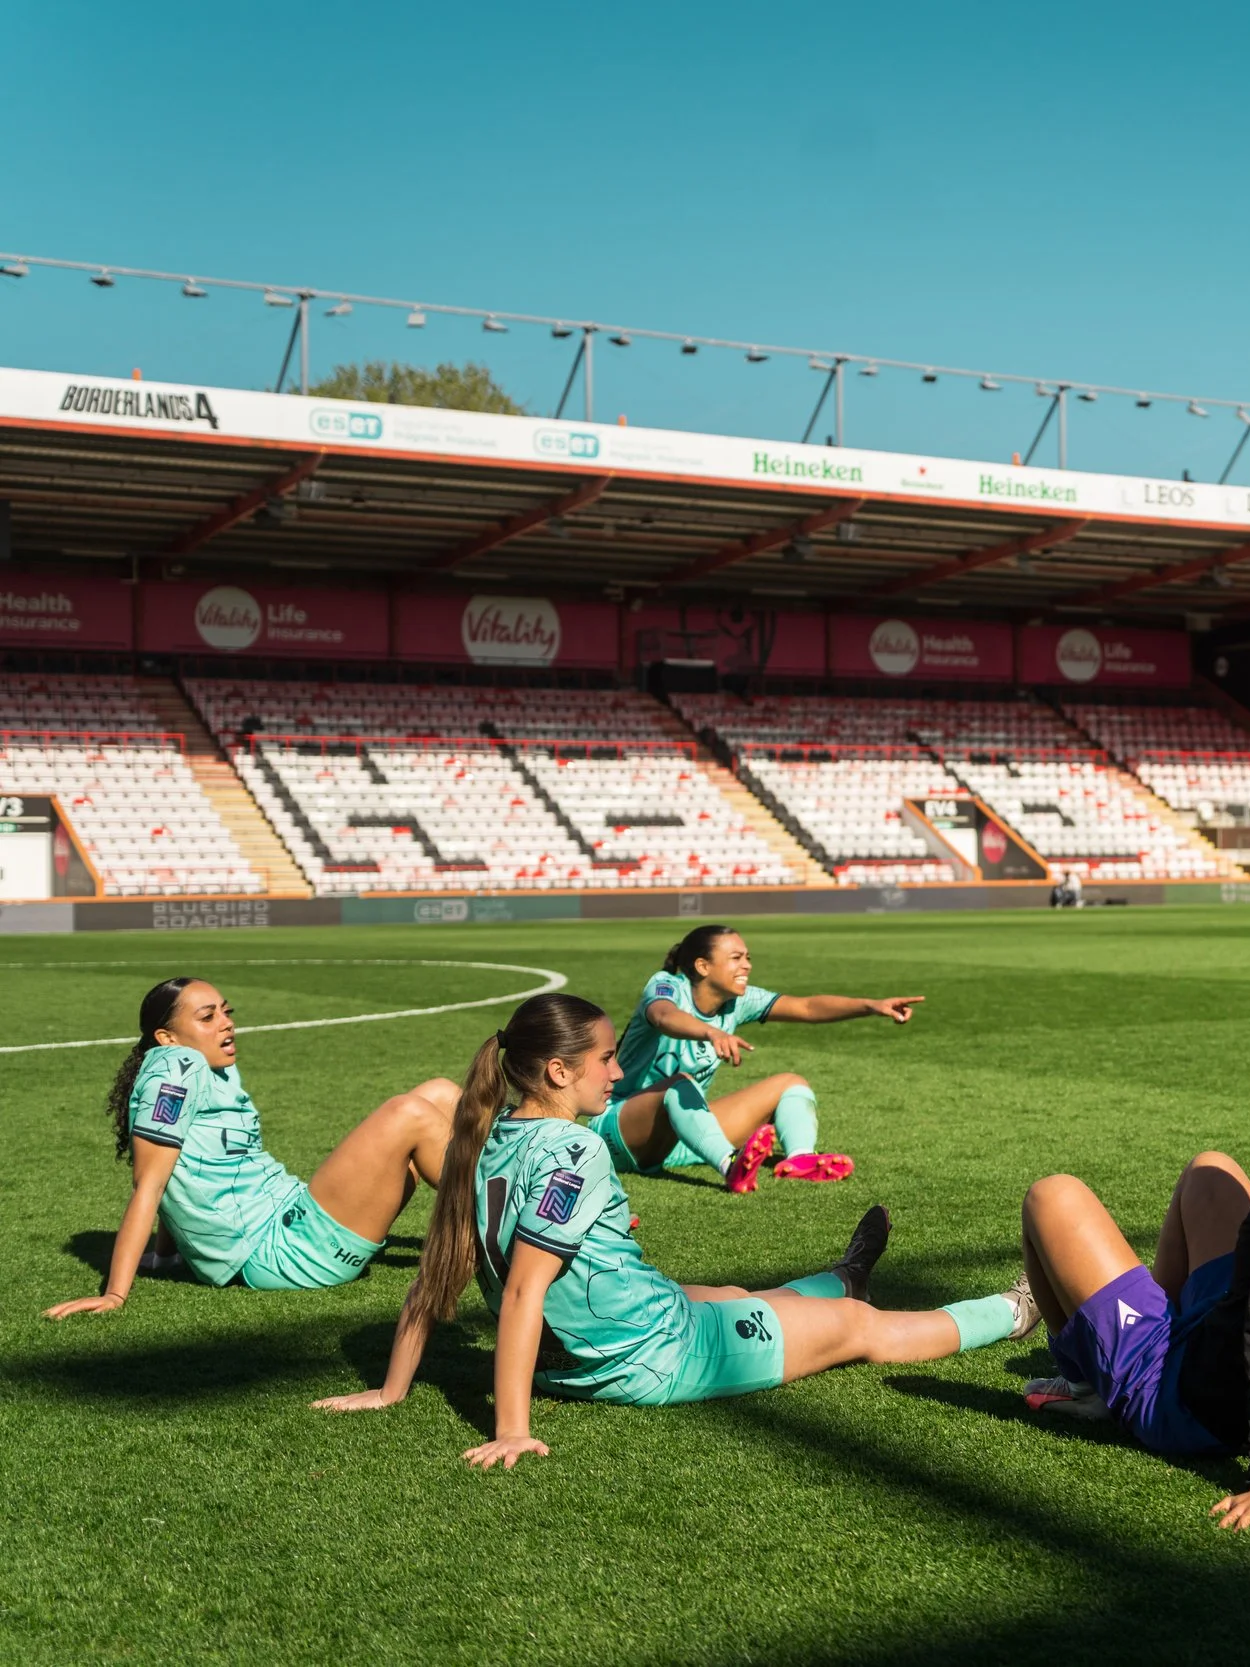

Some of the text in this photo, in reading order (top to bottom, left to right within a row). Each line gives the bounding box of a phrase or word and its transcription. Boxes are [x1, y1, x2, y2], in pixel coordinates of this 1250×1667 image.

[753, 451, 864, 483] Heineken
[979, 473, 1078, 503] Heineken
[1144, 483, 1196, 508] LEOS
[267, 603, 307, 625] Life
[467, 604, 556, 655] Vitality
[923, 633, 974, 653] Health
